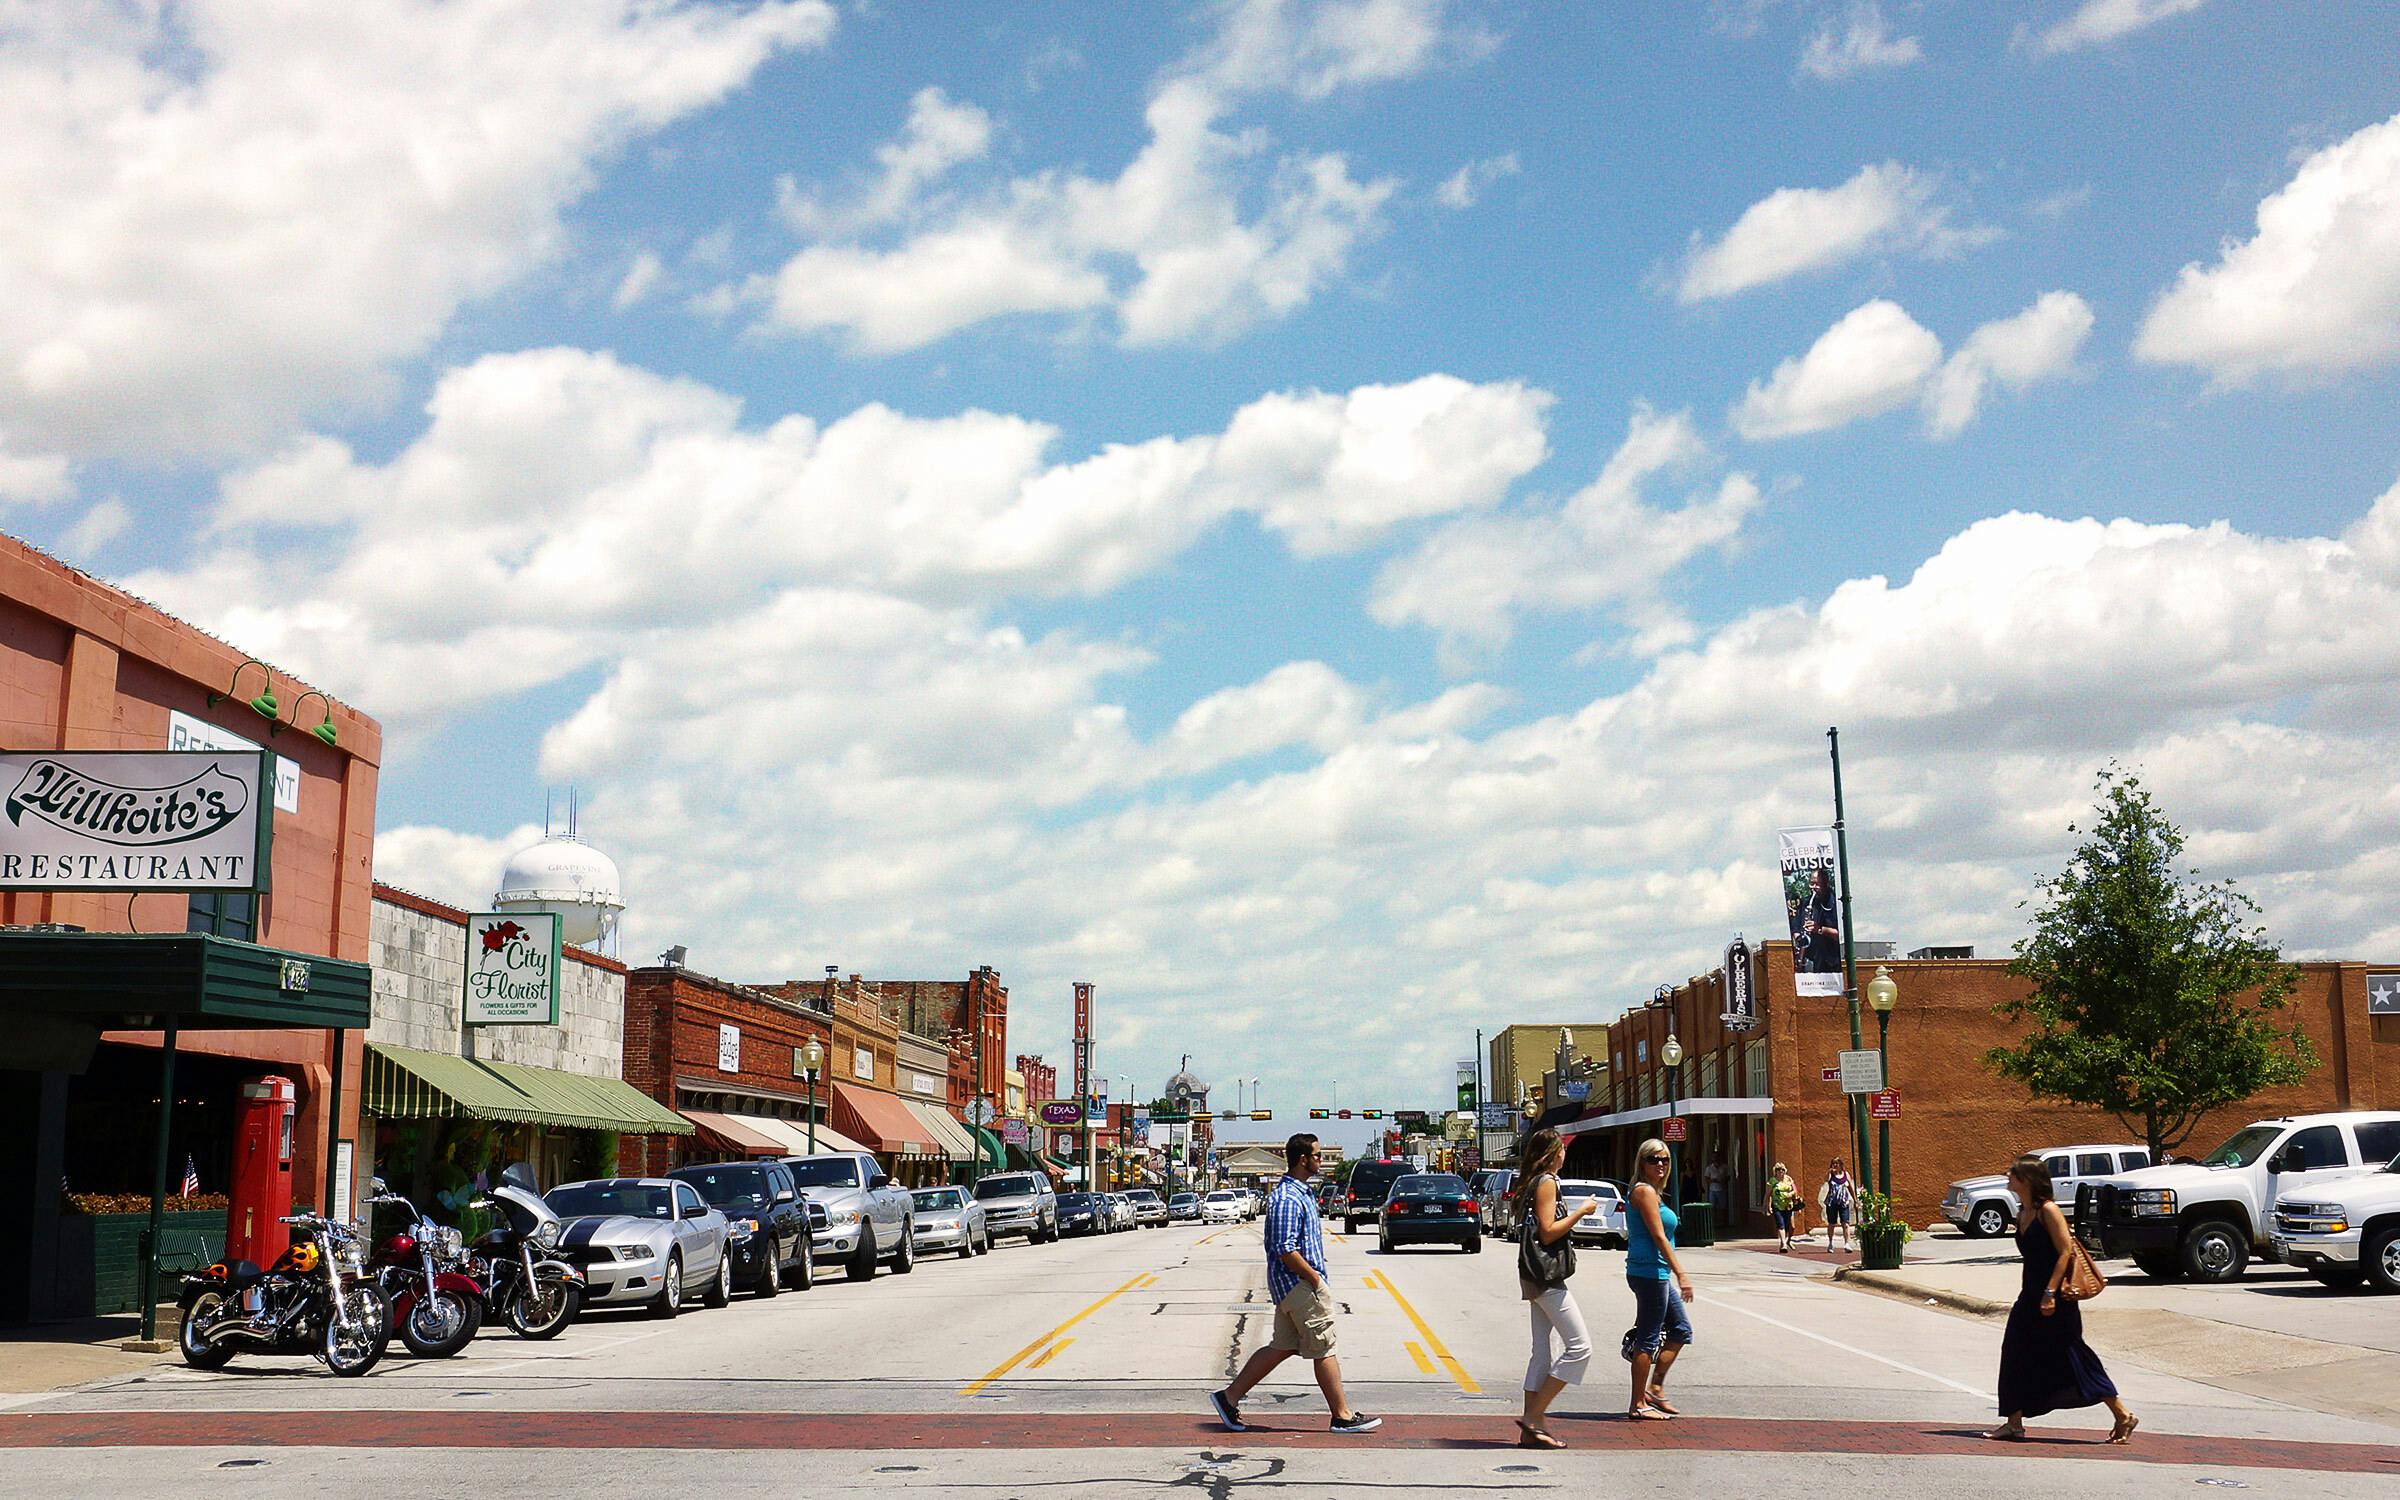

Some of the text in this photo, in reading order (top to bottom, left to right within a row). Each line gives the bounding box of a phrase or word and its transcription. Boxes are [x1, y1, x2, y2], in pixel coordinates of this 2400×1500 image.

[1781, 843, 1832, 857] CELEBRATE
[2, 854, 244, 880] RESTAURANT
[1781, 856, 1835, 871] MUSIC
[507, 941, 547, 977] City
[470, 970, 549, 1000] Florist
[1077, 1044, 1085, 1094] DRUG
[1048, 1106, 1076, 1115] TEXAS
